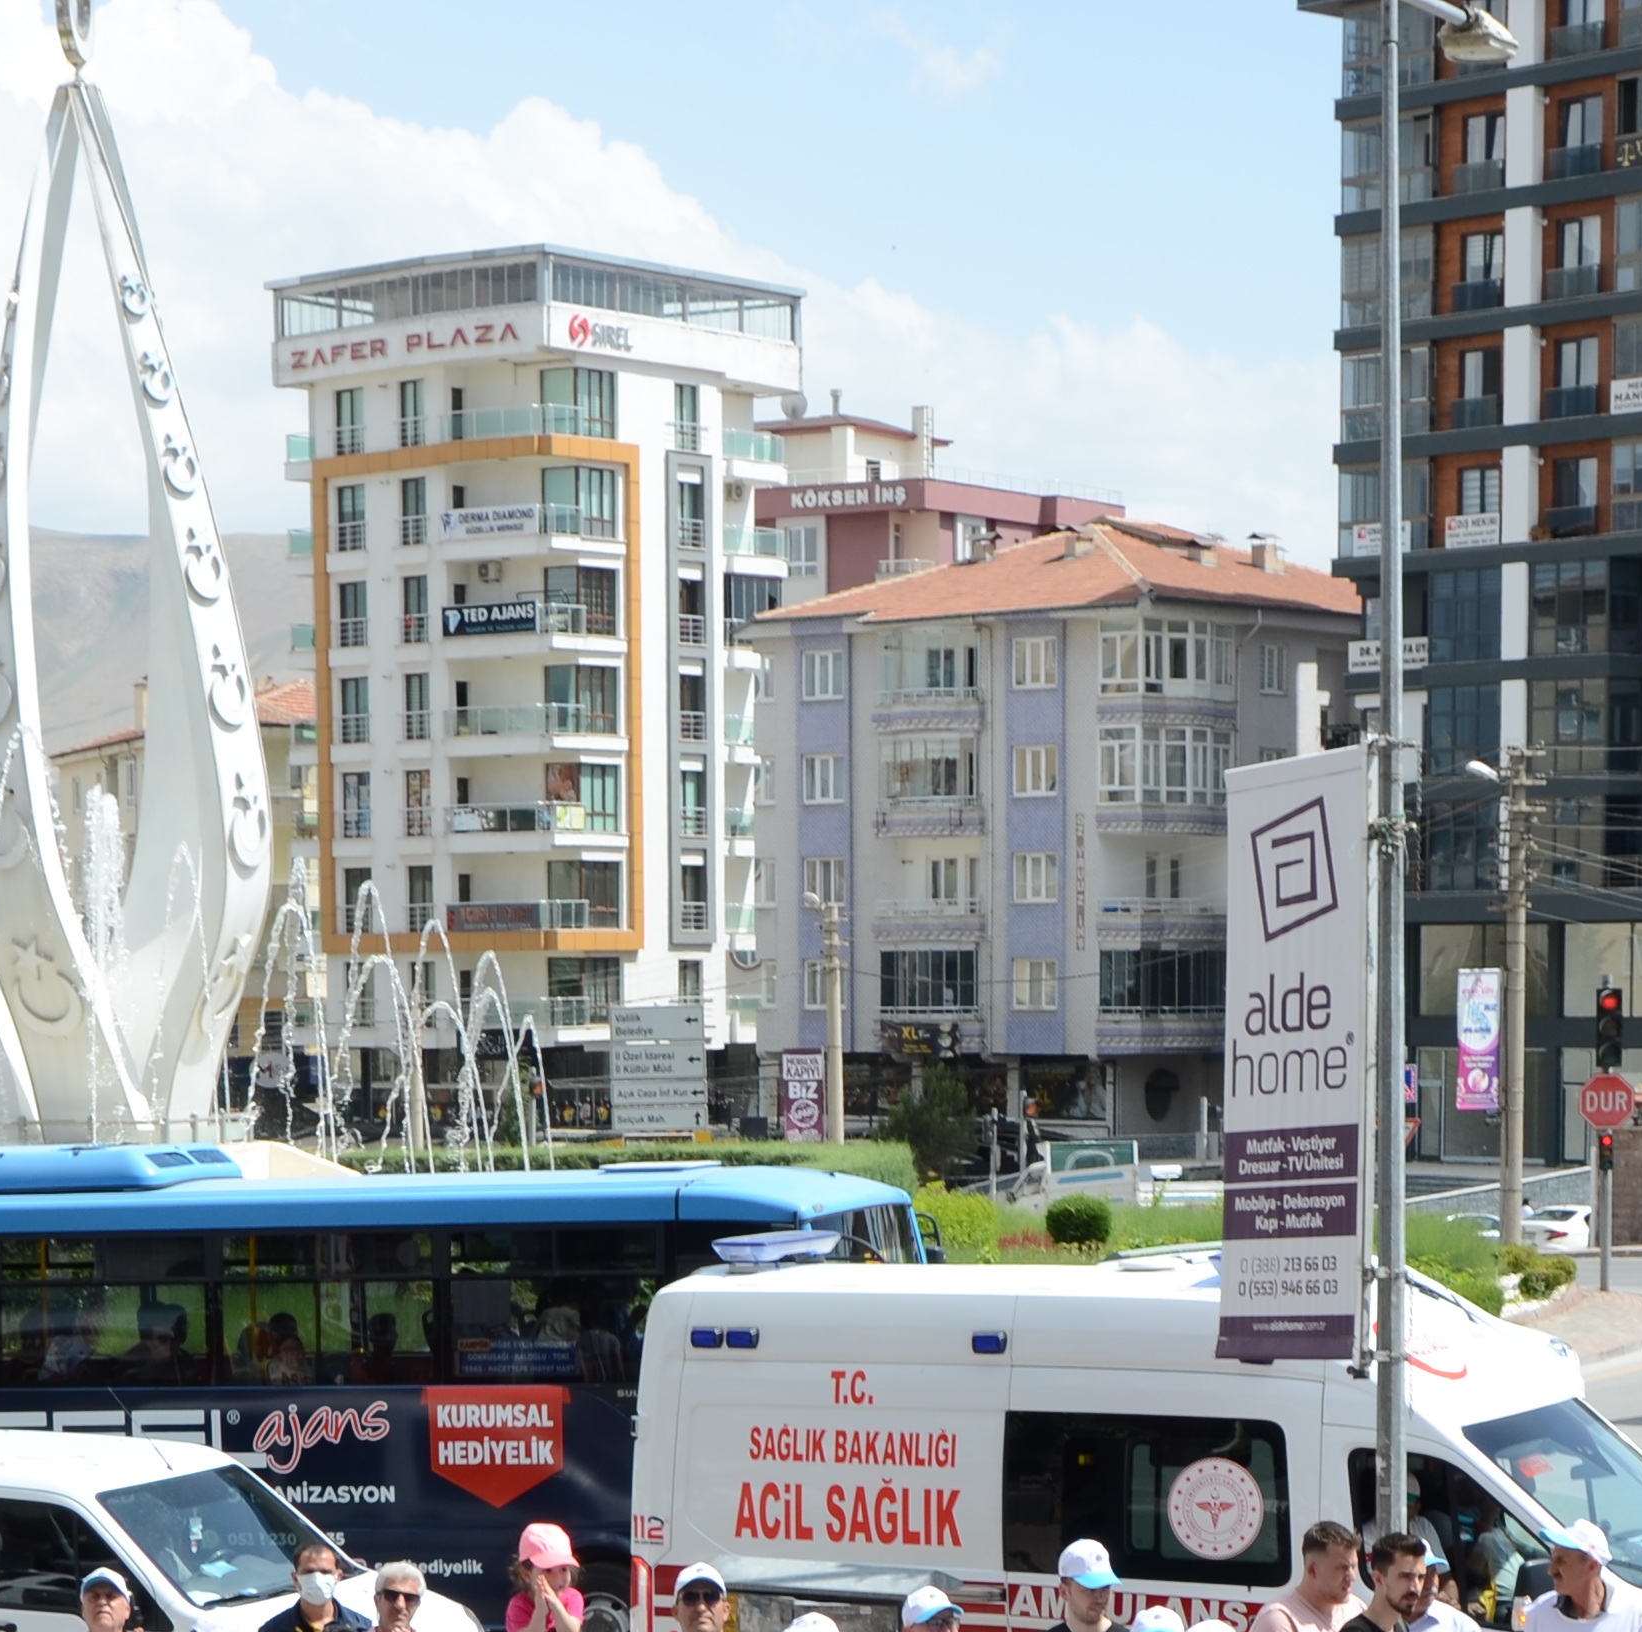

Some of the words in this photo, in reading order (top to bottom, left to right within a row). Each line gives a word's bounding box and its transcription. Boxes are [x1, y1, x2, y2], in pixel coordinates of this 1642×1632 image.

[291, 338, 388, 369] ZAFER
[406, 322, 519, 352] PLAZA
[791, 488, 869, 509] KÖKSEN
[874, 484, 907, 507] İNŞ
[462, 607, 489, 623] TED
[490, 603, 535, 621] AJANS
[1245, 971, 1332, 1036] alde
[615, 1026, 654, 1038] Belediye
[622, 1050, 643, 1060] Özel
[1232, 1038, 1348, 1098] home
[1584, 1090, 1628, 1114] DUR
[1246, 1136, 1286, 1155] Mutfak
[1290, 1134, 1337, 1154] Vestiyer
[1238, 1159, 1281, 1175] Dresuar
[1303, 1152, 1344, 1171] Ünitesi
[1235, 1196, 1277, 1215] Mobilya
[1282, 1193, 1346, 1212] Dekorasyon
[1255, 1214, 1279, 1233] Kapı
[1285, 1212, 1324, 1230] Mutfak
[1240, 1258, 1248, 1273] 0
[1283, 1256, 1302, 1273] 213
[1304, 1256, 1319, 1272] 66
[1321, 1256, 1337, 1271] 03
[1238, 1281, 1246, 1297] 0
[1248, 1279, 1279, 1300] (553)
[1280, 1279, 1303, 1295] 946
[1305, 1279, 1320, 1295] 66
[1322, 1279, 1338, 1294] 03
[830, 1370, 875, 1405] T.C.
[436, 1404, 554, 1428] KURUMSAL
[253, 1400, 391, 1475] ajans
[749, 1424, 827, 1463] SAĞLIK
[834, 1428, 957, 1468] BAKANLIĞI
[438, 1436, 555, 1466] HEDİYELİK
[734, 1481, 814, 1541] ACİL
[825, 1477, 962, 1548] SAĞLIK
[633, 1514, 665, 1540] 112
